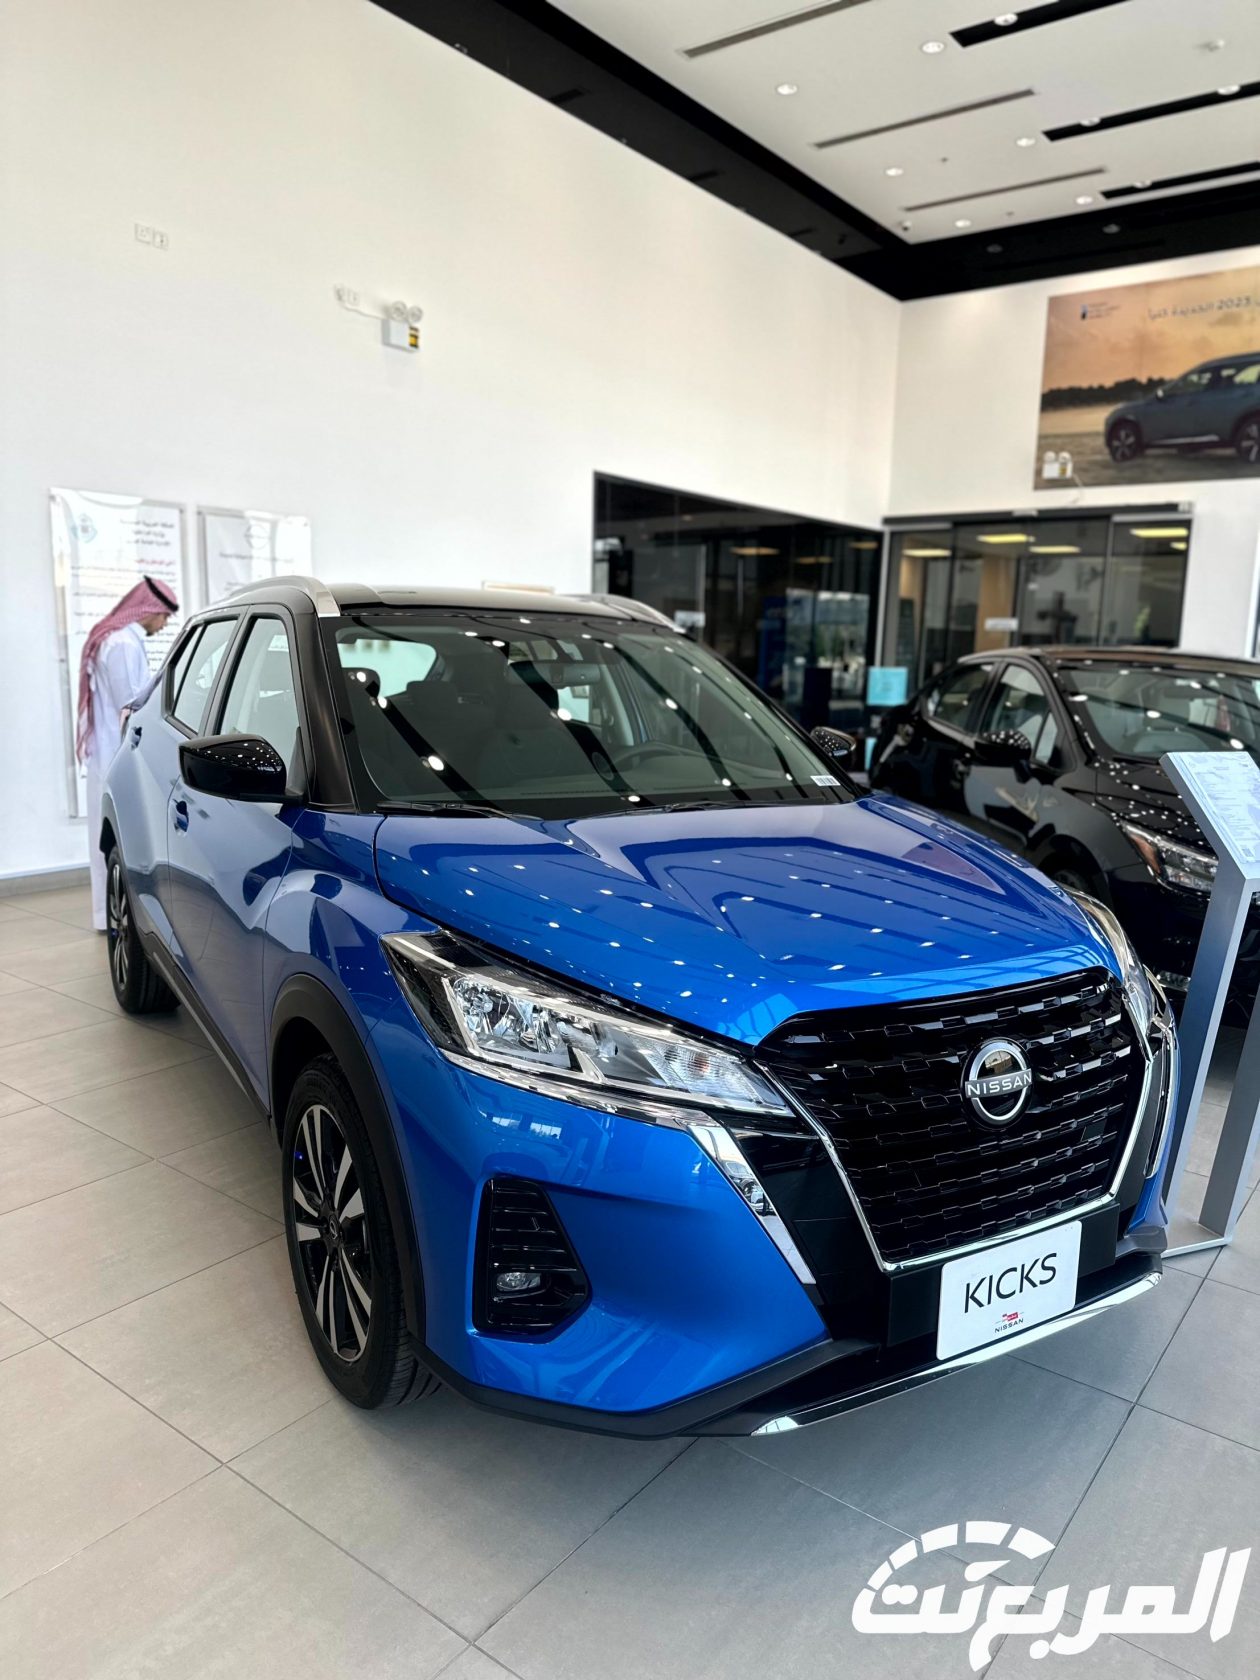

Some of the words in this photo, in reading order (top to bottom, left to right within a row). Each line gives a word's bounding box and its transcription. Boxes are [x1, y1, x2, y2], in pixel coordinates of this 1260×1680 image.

[1217, 295, 1251, 311] 2023
[967, 1071, 1032, 1096] NISSAN
[964, 1252, 1057, 1314] KICKS
[994, 1317, 1024, 1333] NISSAN
